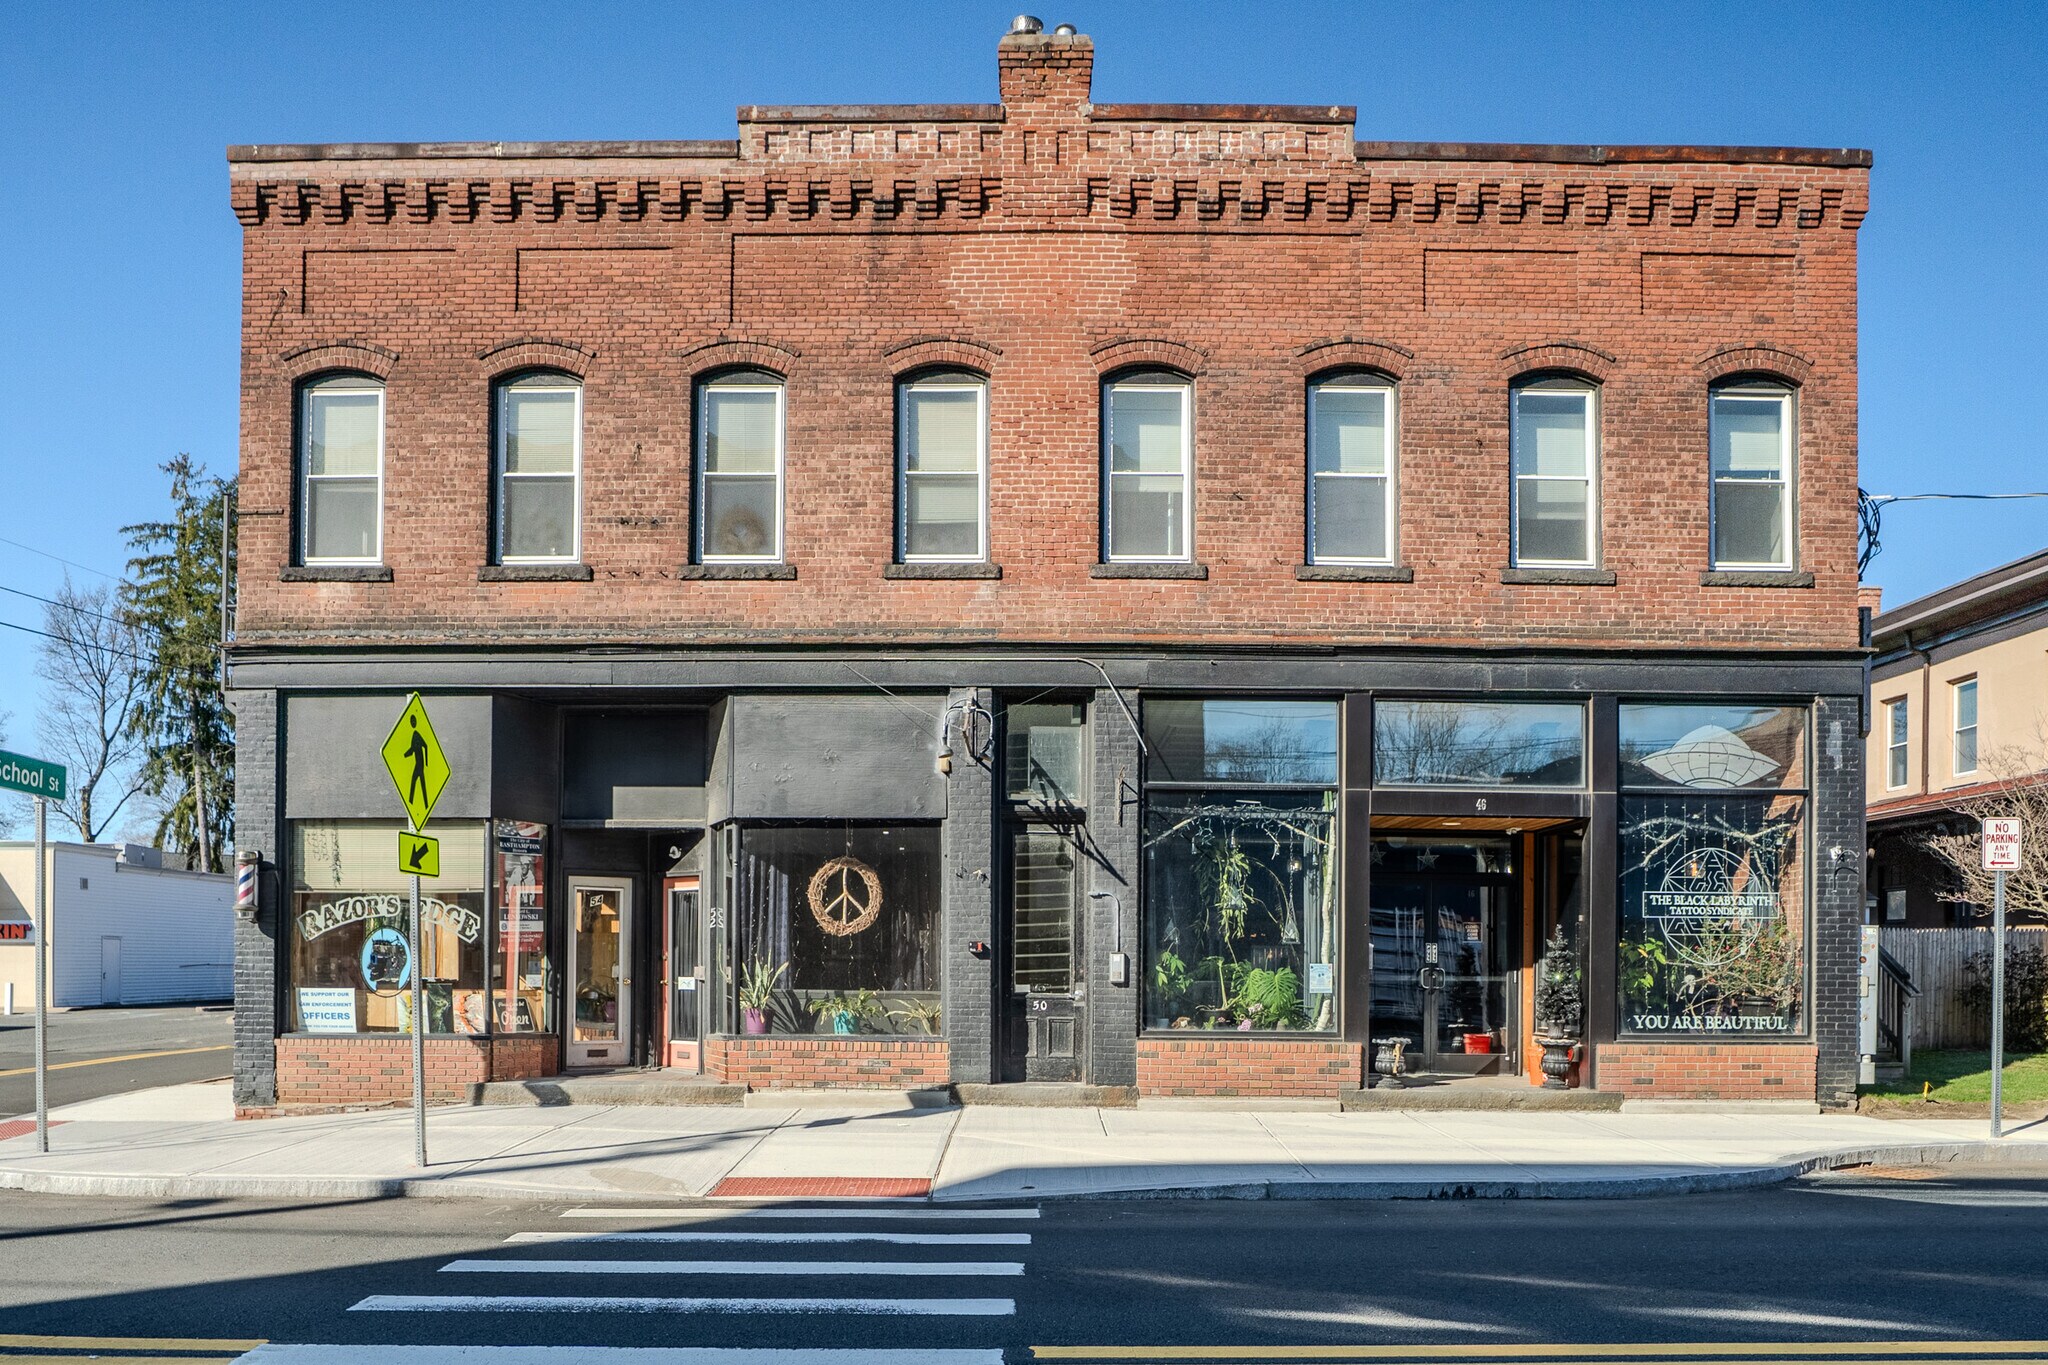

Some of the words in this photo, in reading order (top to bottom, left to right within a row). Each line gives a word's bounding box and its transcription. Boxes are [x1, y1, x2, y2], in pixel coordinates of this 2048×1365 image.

[0, 760, 44, 788] chool
[49, 776, 59, 792] St
[1475, 798, 1487, 811] 46
[1995, 823, 2010, 833] NO
[1986, 833, 2018, 844] PARKING
[499, 841, 541, 850] EASTHAMPTON
[1995, 844, 2009, 852] ANY
[1993, 852, 2011, 860] TIME
[591, 896, 603, 905] 54
[1650, 895, 1672, 905] THE
[1674, 895, 1709, 906] BLACK
[1710, 895, 1773, 906] LABYRINTH
[1669, 907, 1706, 915] TATTOO
[1707, 907, 1754, 916] SYNDICATE
[298, 895, 401, 941] RAZOR'S
[1033, 1000, 1047, 1011] 50
[302, 1012, 350, 1020] OFFICERS
[501, 1011, 530, 1026] Open
[1633, 1015, 1669, 1029] YOU
[1672, 1015, 1701, 1030] ARE
[1705, 1016, 1788, 1030] BEAUTIFUL
